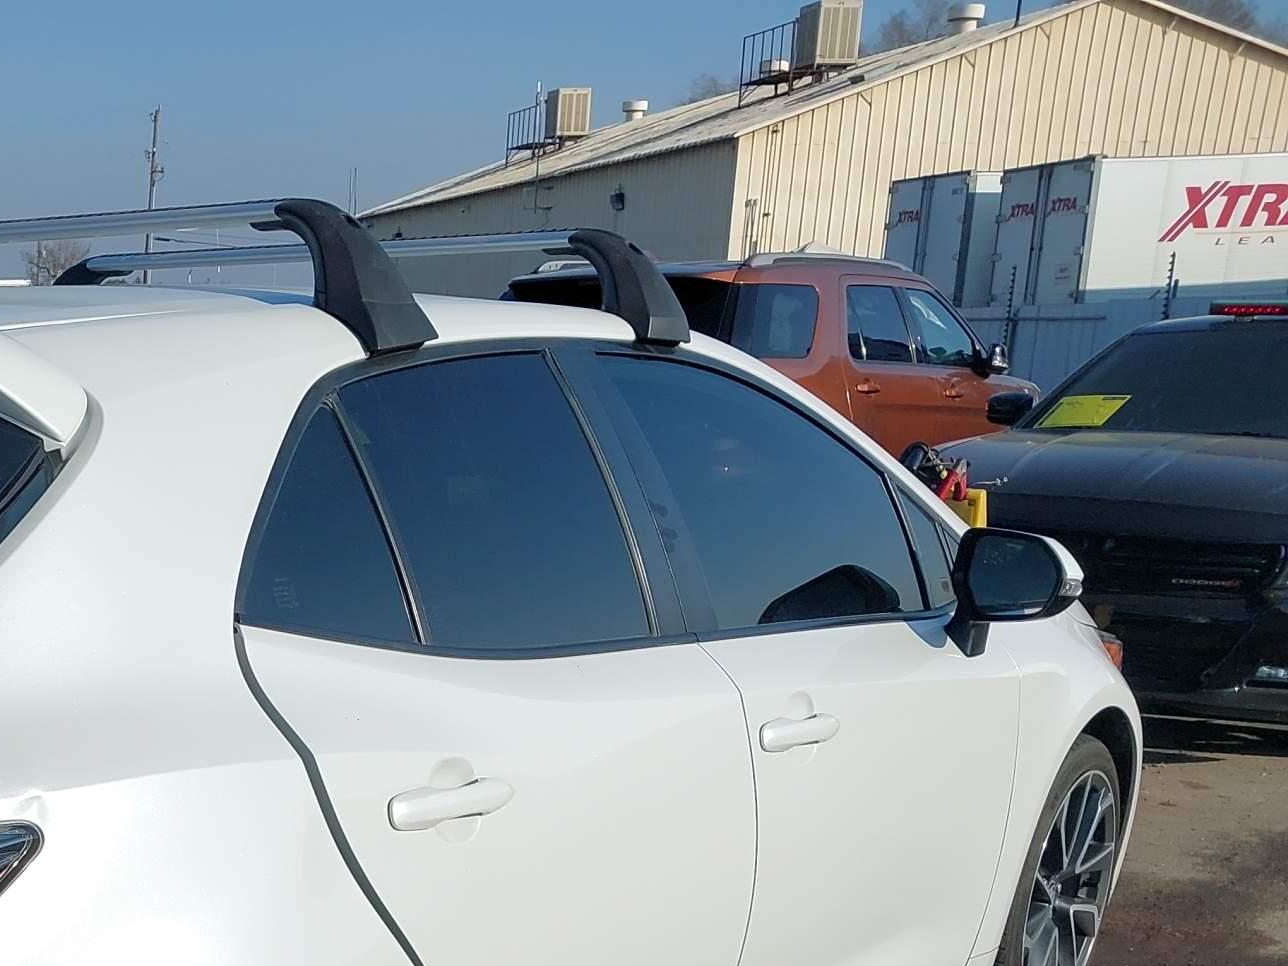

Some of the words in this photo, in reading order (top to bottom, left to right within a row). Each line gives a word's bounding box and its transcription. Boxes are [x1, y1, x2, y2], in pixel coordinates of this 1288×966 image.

[1006, 203, 1036, 221] XTRA
[1046, 197, 1077, 217] XTRA
[896, 209, 921, 226] XTRA
